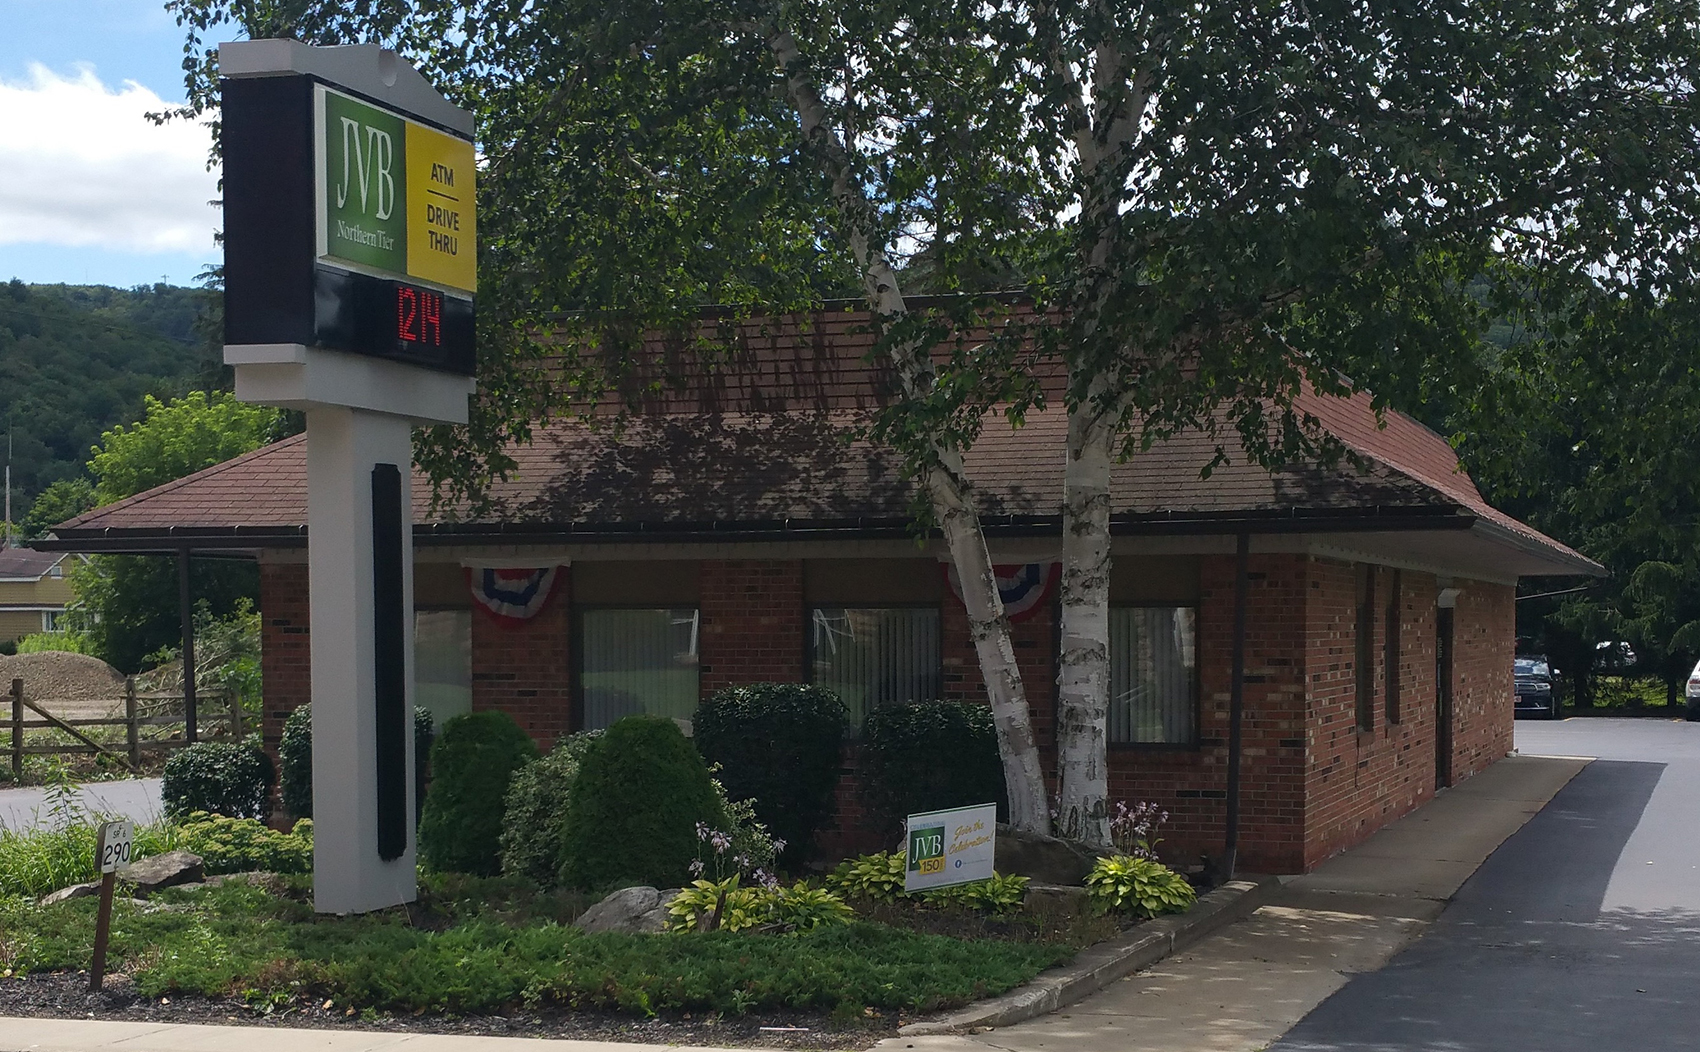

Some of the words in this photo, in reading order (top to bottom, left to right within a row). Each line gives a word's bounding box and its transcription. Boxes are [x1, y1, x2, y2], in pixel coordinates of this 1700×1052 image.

[337, 116, 394, 220] JVB
[430, 162, 454, 187] ATM
[427, 204, 459, 231] DRIVE
[337, 219, 377, 247] Northern
[377, 229, 394, 251] Tier
[428, 229, 458, 256] THRU
[103, 841, 131, 866] 290
[912, 834, 941, 864] JVB
[921, 859, 940, 872] 150
